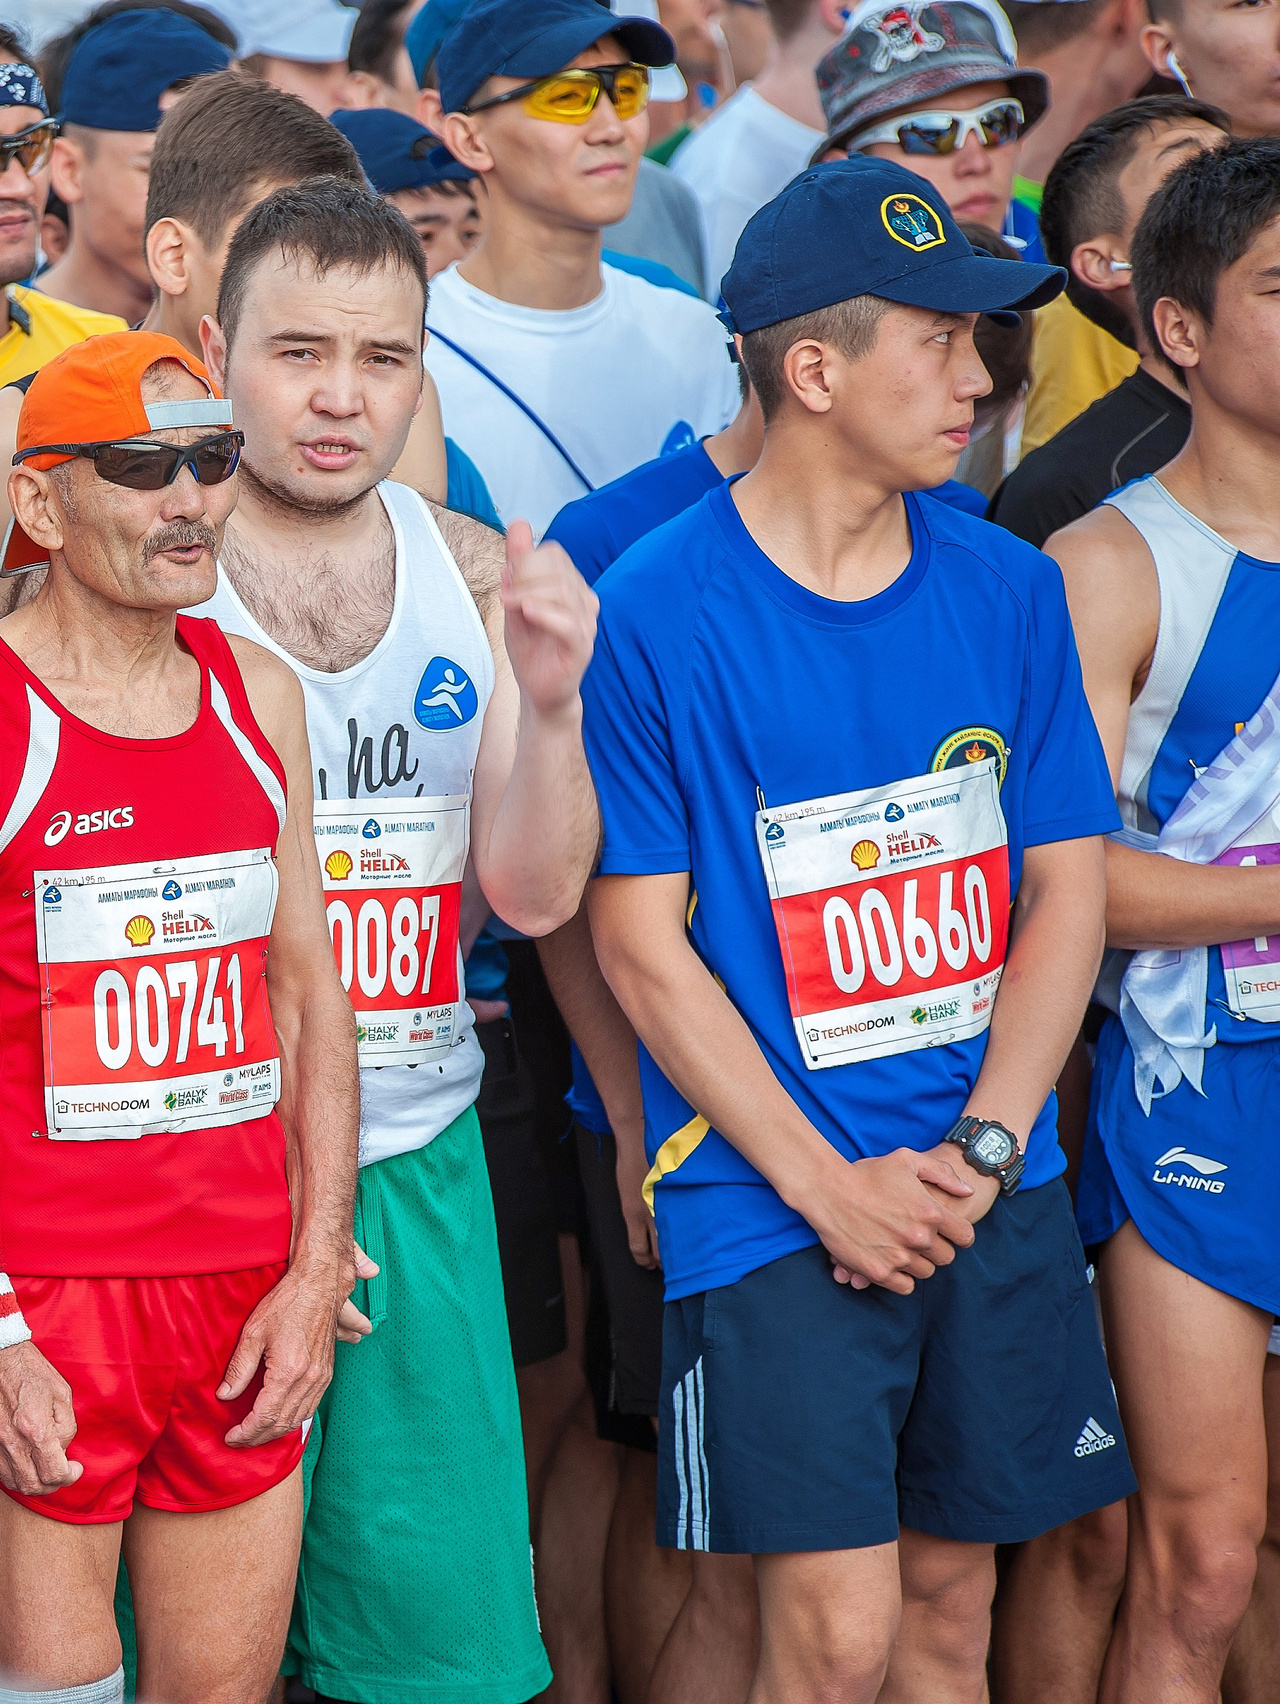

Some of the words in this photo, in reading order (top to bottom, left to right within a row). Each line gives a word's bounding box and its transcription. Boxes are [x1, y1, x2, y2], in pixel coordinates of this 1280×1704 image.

[74, 806, 134, 835] asics
[384, 823, 406, 833] ALMATY
[407, 822, 435, 832] MARATHON
[326, 824, 358, 834] МАРАФОНЫ
[886, 830, 908, 844] Shell
[360, 848, 382, 858] Shell
[888, 835, 940, 857] HELIX
[360, 856, 408, 872] HELIX
[52, 877, 62, 886] 42
[64, 877, 78, 885] km
[184, 882, 206, 894] ALMATY
[206, 878, 236, 891] MARATHON
[98, 892, 124, 903] АЛМАТЫ
[124, 888, 158, 900] МАРАФОНЫ
[162, 910, 184, 922] Shell
[162, 915, 214, 936] HELIX
[822, 864, 992, 994] 00660
[94, 952, 244, 1070] 00741
[928, 1000, 961, 1012] HALYK
[426, 1008, 452, 1020] MYLAPS
[930, 1008, 959, 1020] BANK
[368, 1026, 400, 1034] HALYK
[820, 1016, 895, 1040] TECHNODOM
[239, 1064, 270, 1080] MYLAPS
[178, 1088, 208, 1099] HALYK
[258, 1082, 272, 1091] AIMS
[71, 1100, 150, 1114] TECHNODOM
[178, 1097, 204, 1106] BANK
[1152, 1170, 1226, 1194] LI-NING
[1074, 1434, 1116, 1458] adidas
